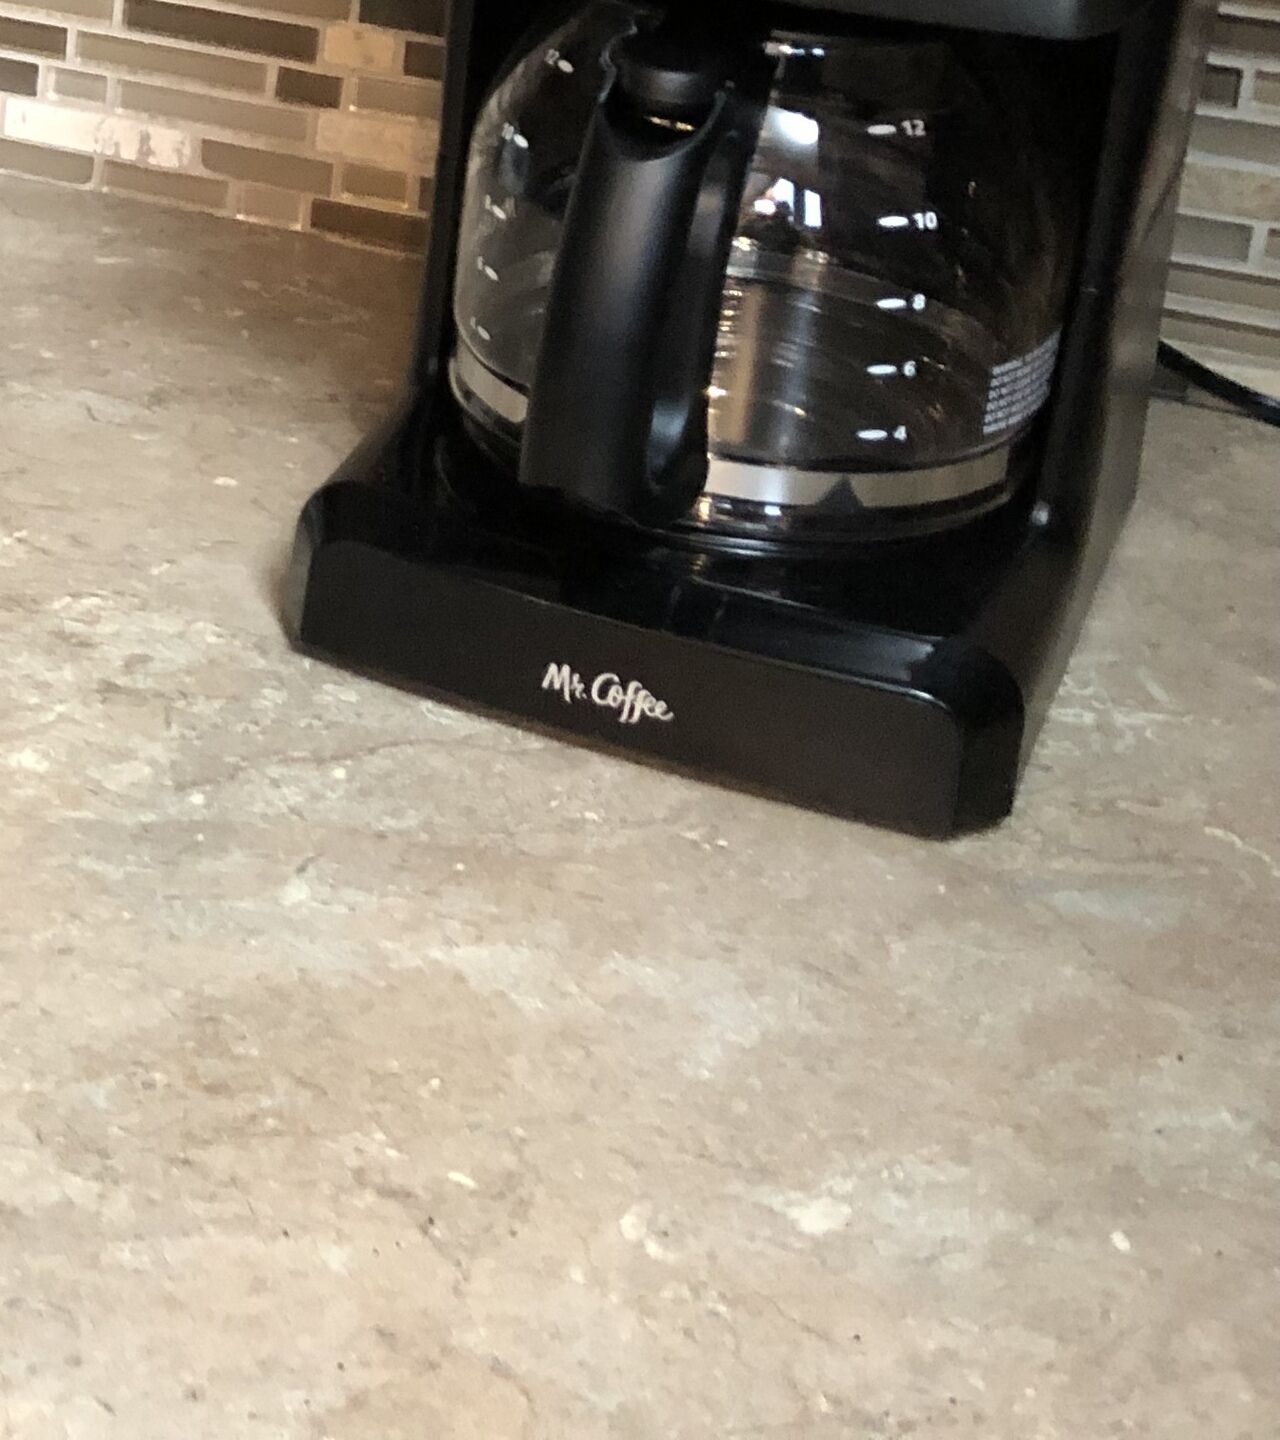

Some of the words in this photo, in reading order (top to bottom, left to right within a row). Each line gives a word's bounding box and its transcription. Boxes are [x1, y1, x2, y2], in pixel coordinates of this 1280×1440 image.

[901, 119, 926, 137] 12
[912, 211, 938, 231] 10
[912, 293, 926, 312] 8
[903, 360, 917, 378] 6
[892, 425, 907, 442] 4
[541, 662, 588, 704] Mr.
[591, 672, 675, 724] Coffee
